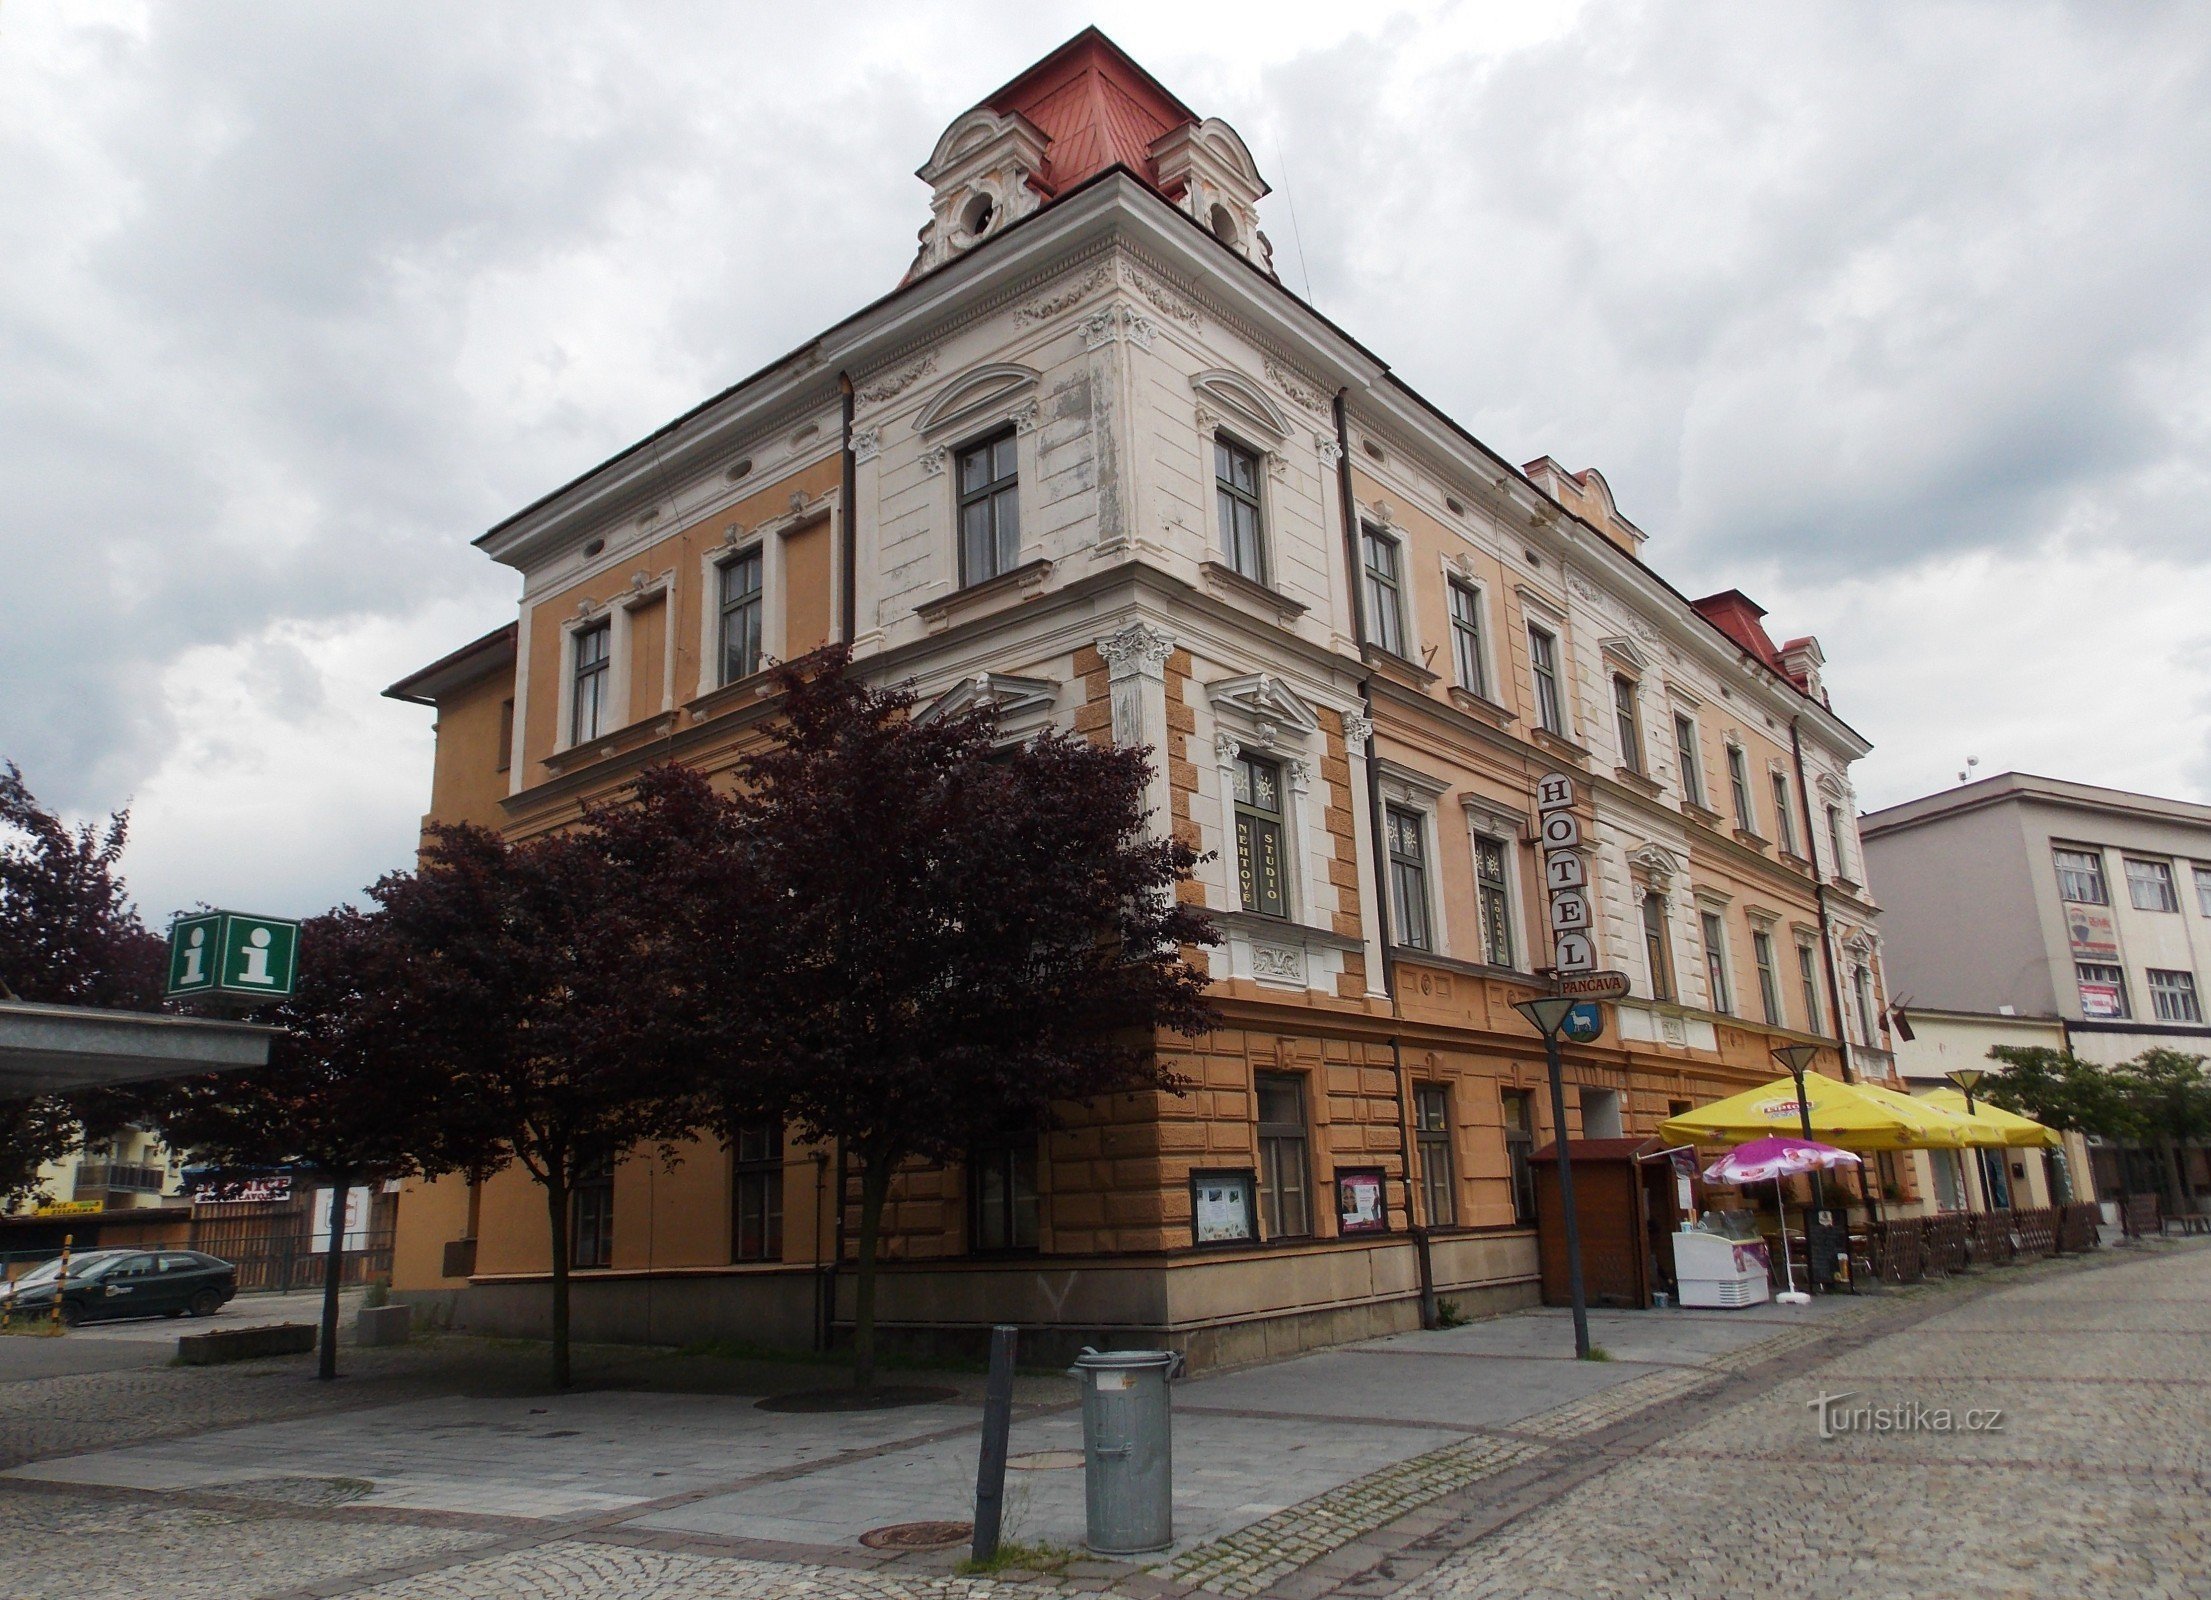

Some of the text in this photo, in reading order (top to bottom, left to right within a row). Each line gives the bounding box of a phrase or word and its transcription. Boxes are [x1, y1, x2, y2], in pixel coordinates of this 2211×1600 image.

[1238, 823, 1251, 903] NEHTOVÉ
[1264, 834, 1277, 899] STUDIO
[1540, 779, 1585, 965] HOTEL
[1562, 976, 1622, 993] PANČAVA
